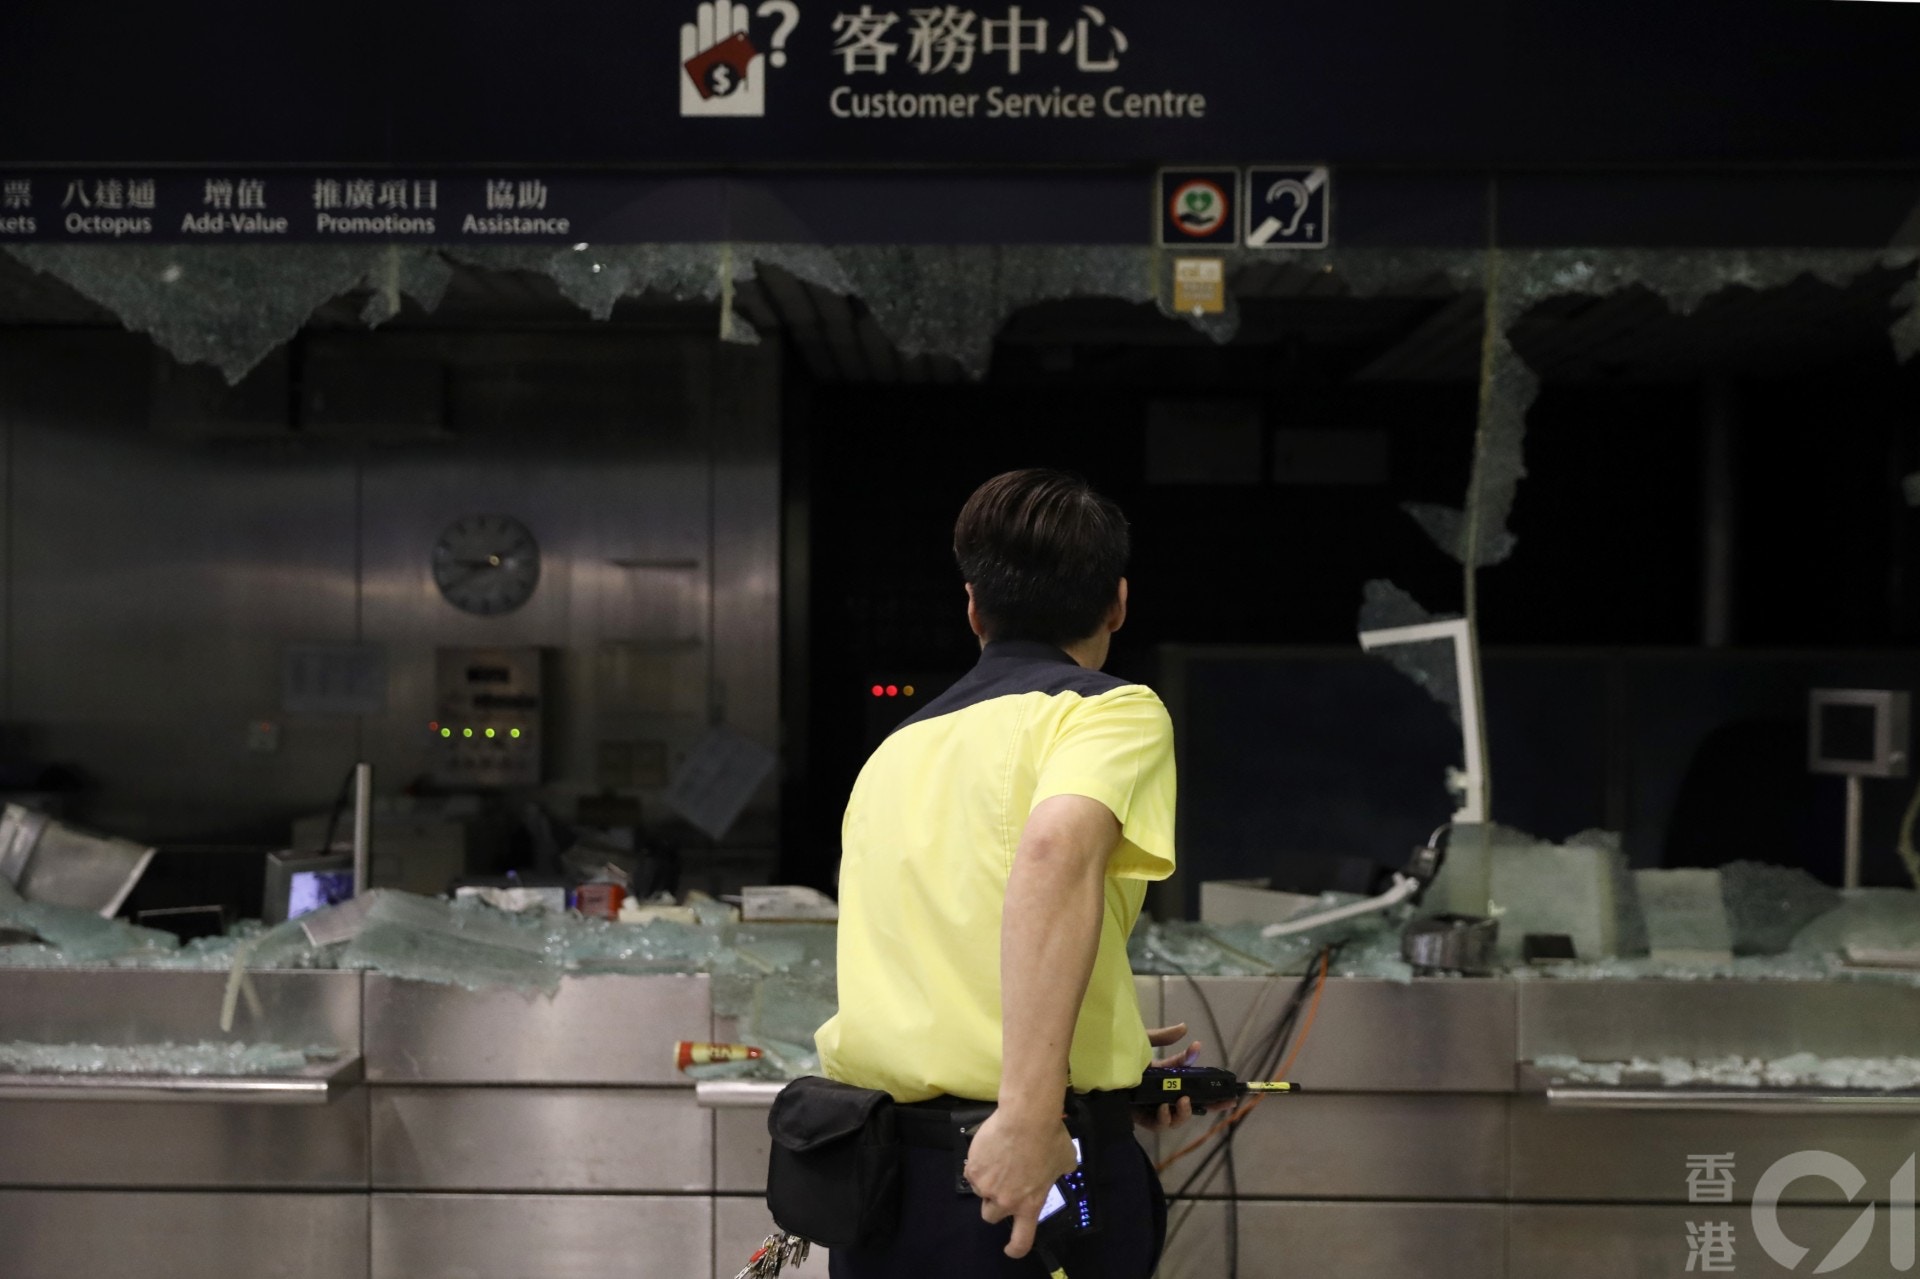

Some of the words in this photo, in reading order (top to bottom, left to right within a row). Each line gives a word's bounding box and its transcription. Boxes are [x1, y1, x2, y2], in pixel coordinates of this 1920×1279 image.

[831, 4, 1128, 75] 客務中心
[829, 86, 980, 119] Customer
[986, 86, 1096, 119] Service
[1102, 86, 1206, 119] Centre
[4, 180, 31, 209] 票
[62, 179, 156, 209] 八達通
[203, 179, 266, 209] 增值
[313, 179, 437, 210] 推廣項目
[486, 179, 548, 210] 協助
[65, 213, 152, 237] Octopus
[181, 213, 288, 234] Add-Value
[316, 213, 436, 235] Promotions
[462, 213, 570, 235] Assistance
